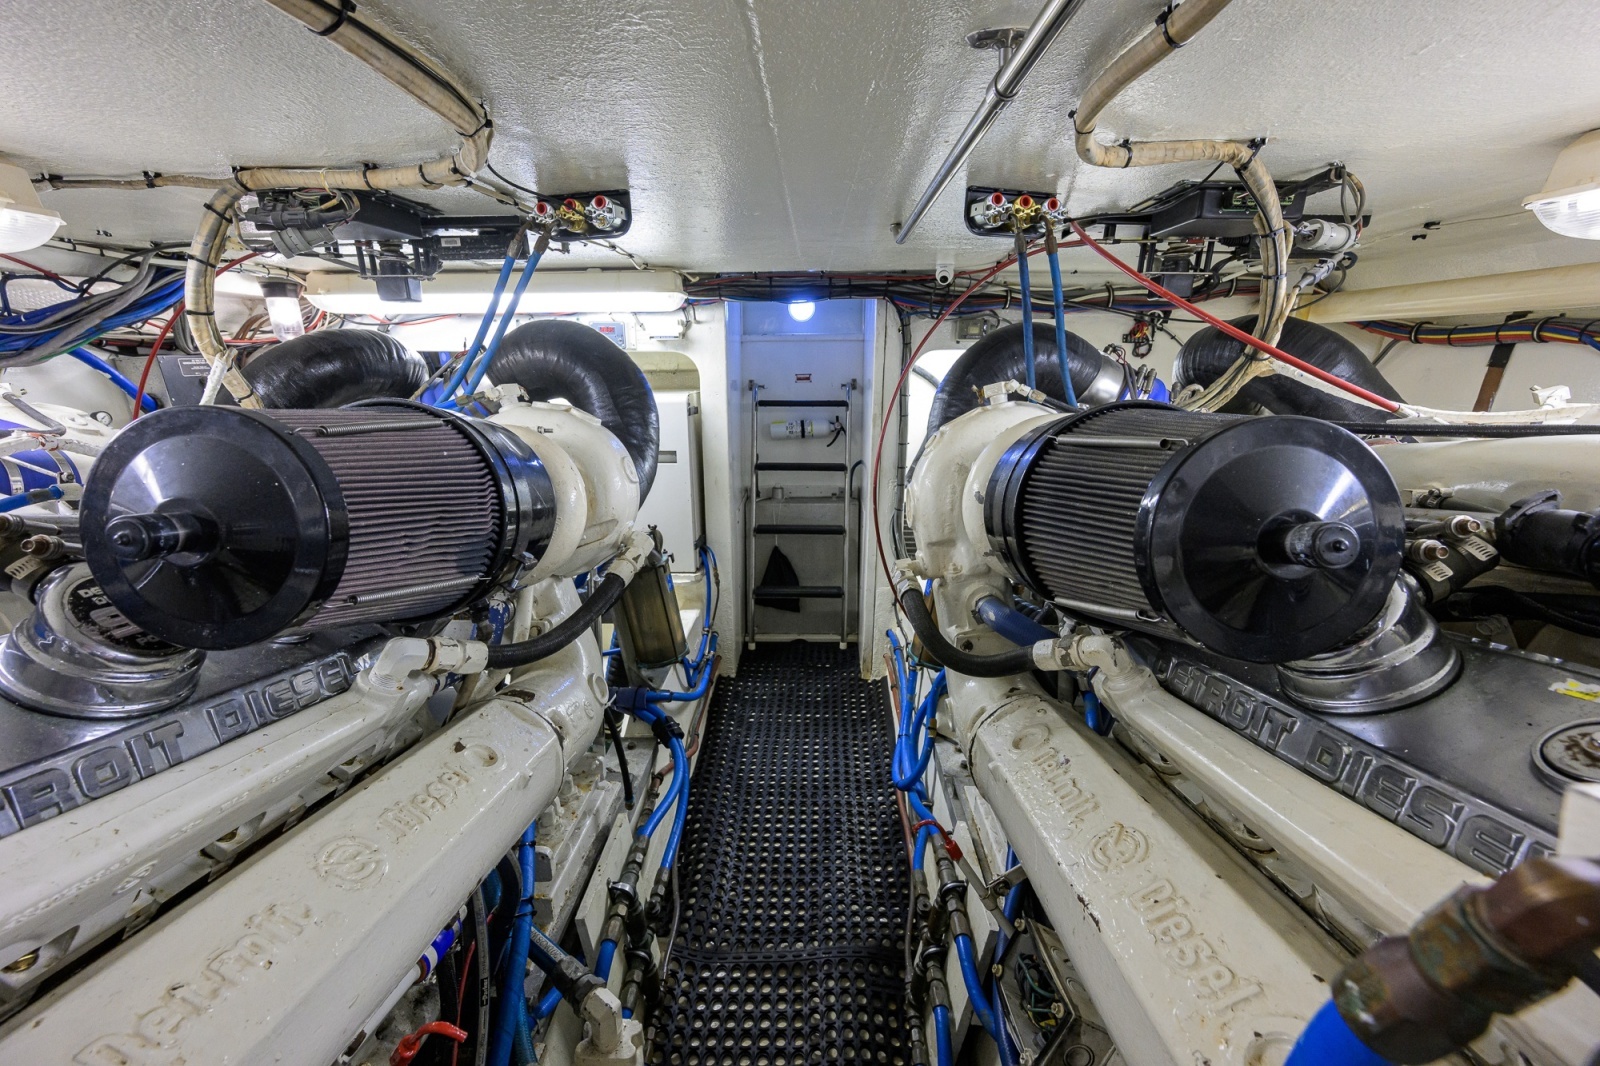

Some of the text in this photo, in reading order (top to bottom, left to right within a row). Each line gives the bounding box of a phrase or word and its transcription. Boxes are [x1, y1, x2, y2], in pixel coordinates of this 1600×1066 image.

[0, 720, 185, 831] ROIT
[1305, 729, 1557, 878] DIESE
[1129, 878, 1265, 1014] Diesel
